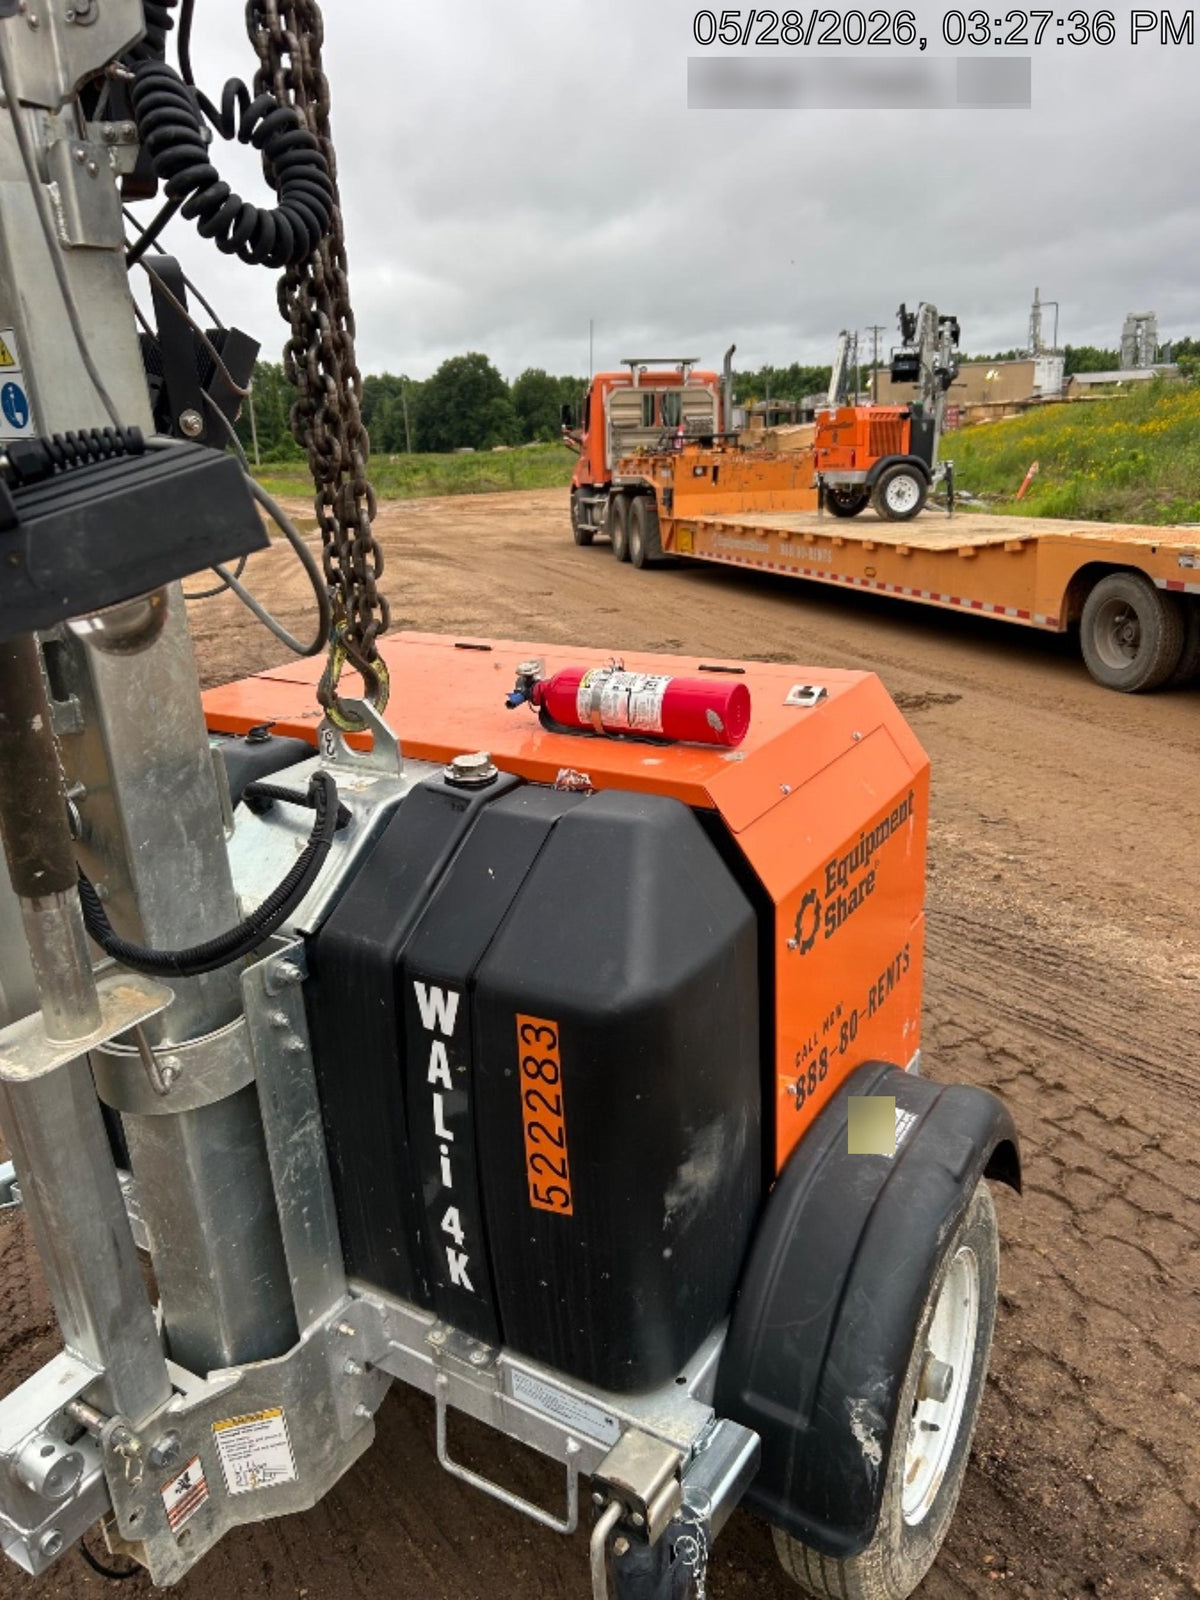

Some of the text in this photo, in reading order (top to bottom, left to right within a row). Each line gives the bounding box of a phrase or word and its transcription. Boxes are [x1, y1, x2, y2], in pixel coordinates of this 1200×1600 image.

[824, 789, 914, 900] Equipment
[795, 942, 910, 1112] 888-80-RENTS
[795, 1031, 819, 1068] CALL
[520, 1022, 571, 1209] 522283
